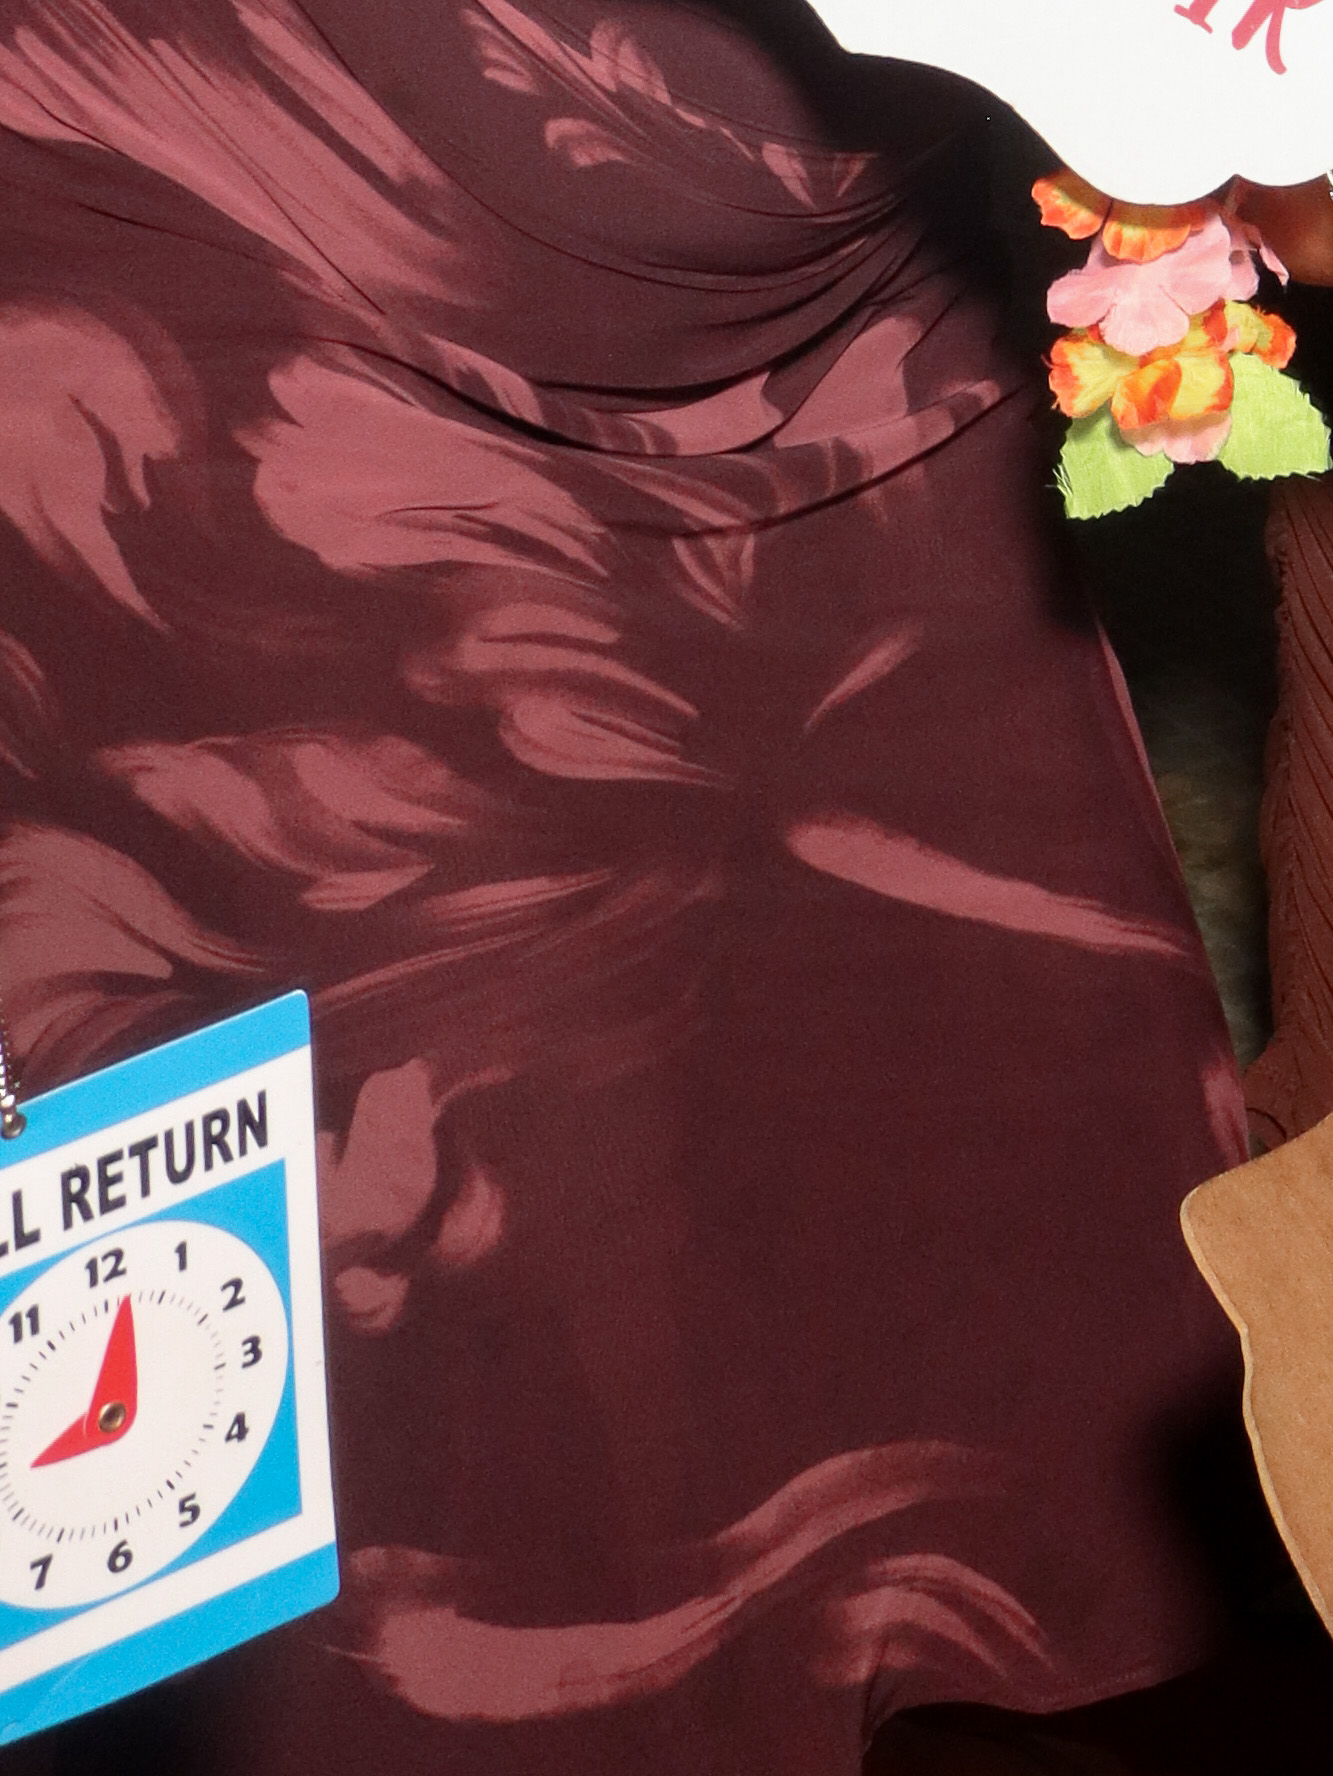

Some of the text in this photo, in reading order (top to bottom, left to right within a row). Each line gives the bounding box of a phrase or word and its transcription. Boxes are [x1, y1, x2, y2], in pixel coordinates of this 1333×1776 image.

[0, 1090, 269, 1258] L RETURN
[86, 1249, 127, 1289] 12
[175, 1242, 188, 1272] 1
[221, 1278, 246, 1312] 2
[9, 1305, 40, 1344] 11
[241, 1335, 263, 1369] 3
[224, 1412, 249, 1444] 4
[178, 1494, 200, 1528] 5
[30, 1555, 53, 1590] 7
[107, 1541, 133, 1574] 6
